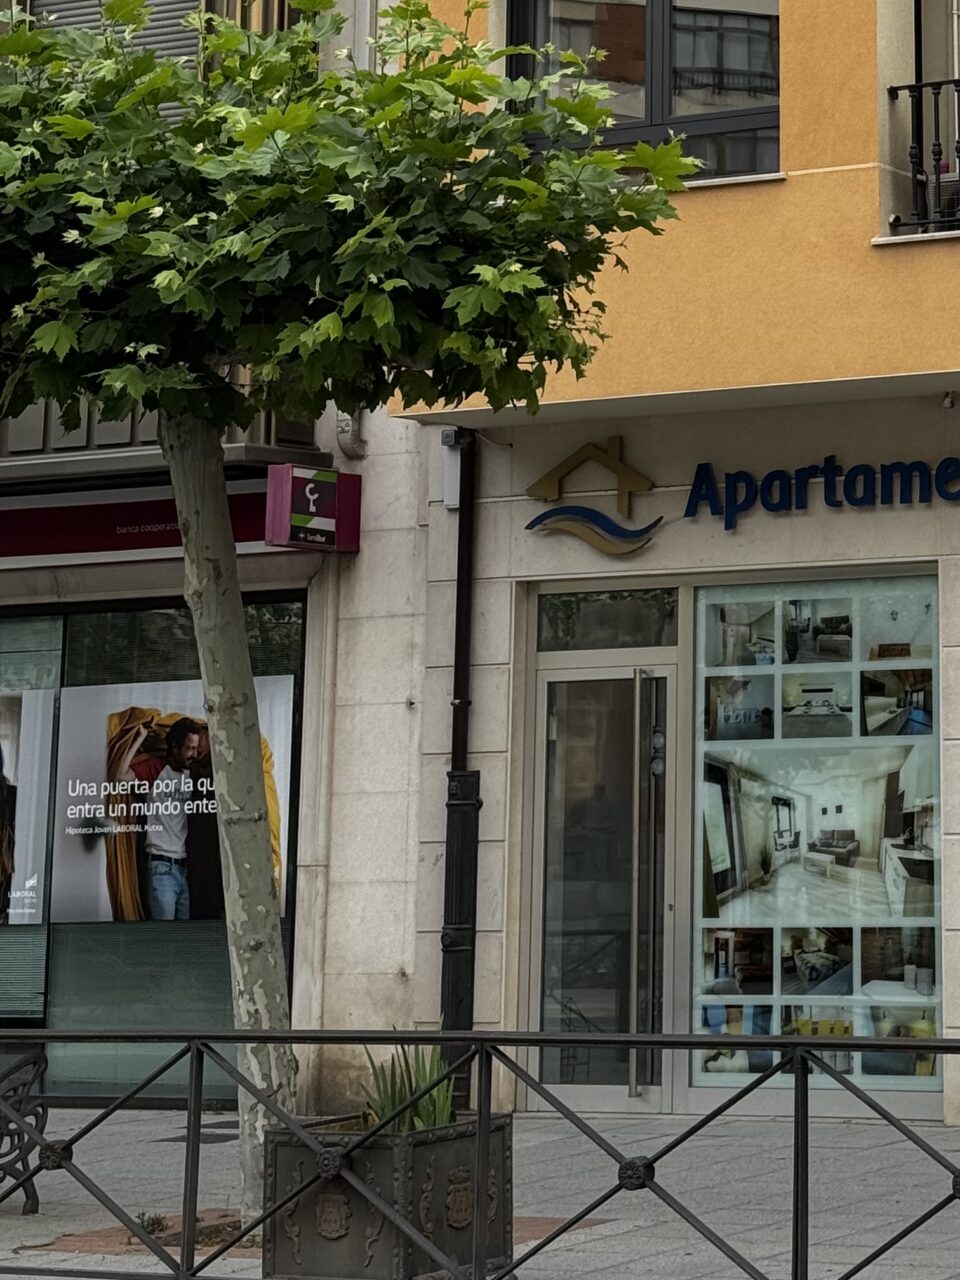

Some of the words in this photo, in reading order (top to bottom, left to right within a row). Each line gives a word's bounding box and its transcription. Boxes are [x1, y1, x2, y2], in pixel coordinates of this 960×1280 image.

[116, 525, 139, 534] banca
[140, 523, 182, 533] cooperati
[68, 780, 97, 797] Una
[100, 780, 149, 799] puerta
[153, 778, 178, 797] por
[180, 774, 194, 793] la
[197, 777, 215, 795] qu
[67, 802, 105, 818] entra
[109, 804, 126, 817] un
[131, 798, 180, 816] mundo
[184, 797, 217, 815] ente
[65, 826, 93, 835] Hipoteca
[112, 824, 143, 833] LABORAL
